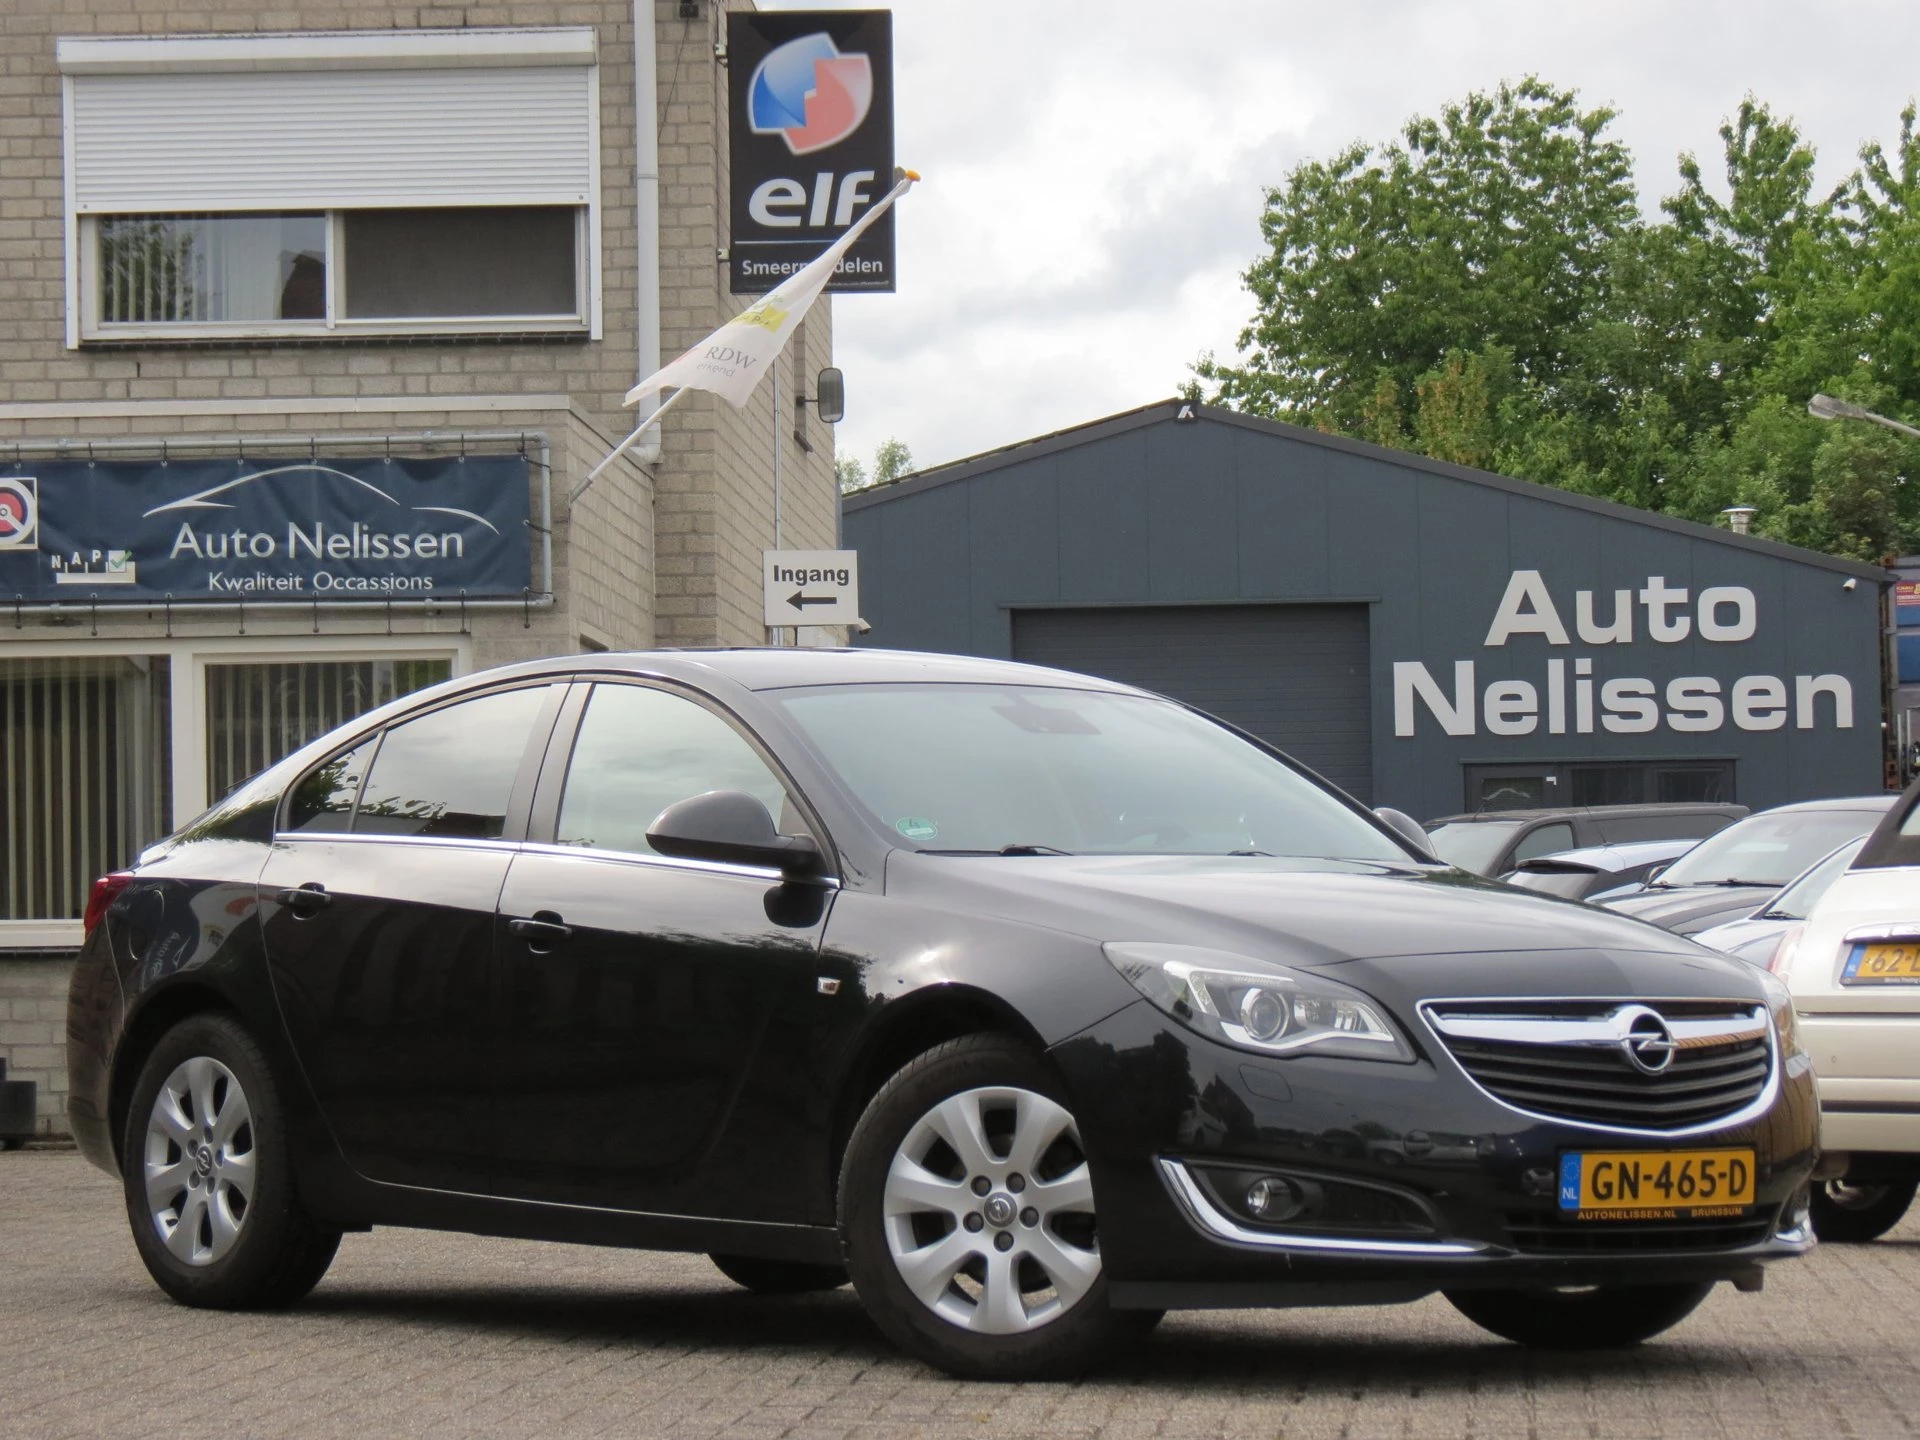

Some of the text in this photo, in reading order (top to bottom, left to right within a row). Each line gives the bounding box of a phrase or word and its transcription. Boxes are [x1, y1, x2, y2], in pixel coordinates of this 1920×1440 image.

[749, 170, 875, 227] elf
[742, 256, 883, 275] Smeerdelen
[704, 345, 757, 369] RDW
[169, 521, 463, 559] Auto Nelissen
[208, 571, 433, 591] Kwaliteit Occassions
[773, 564, 850, 587] Ingang
[1483, 569, 1757, 647] Auto
[1393, 657, 1854, 737] Nelissen
[1562, 1158, 1748, 1201] NL GN-465-D
[1577, 1206, 1743, 1220] AUTONELISSEN.NL BRUNSSUM
